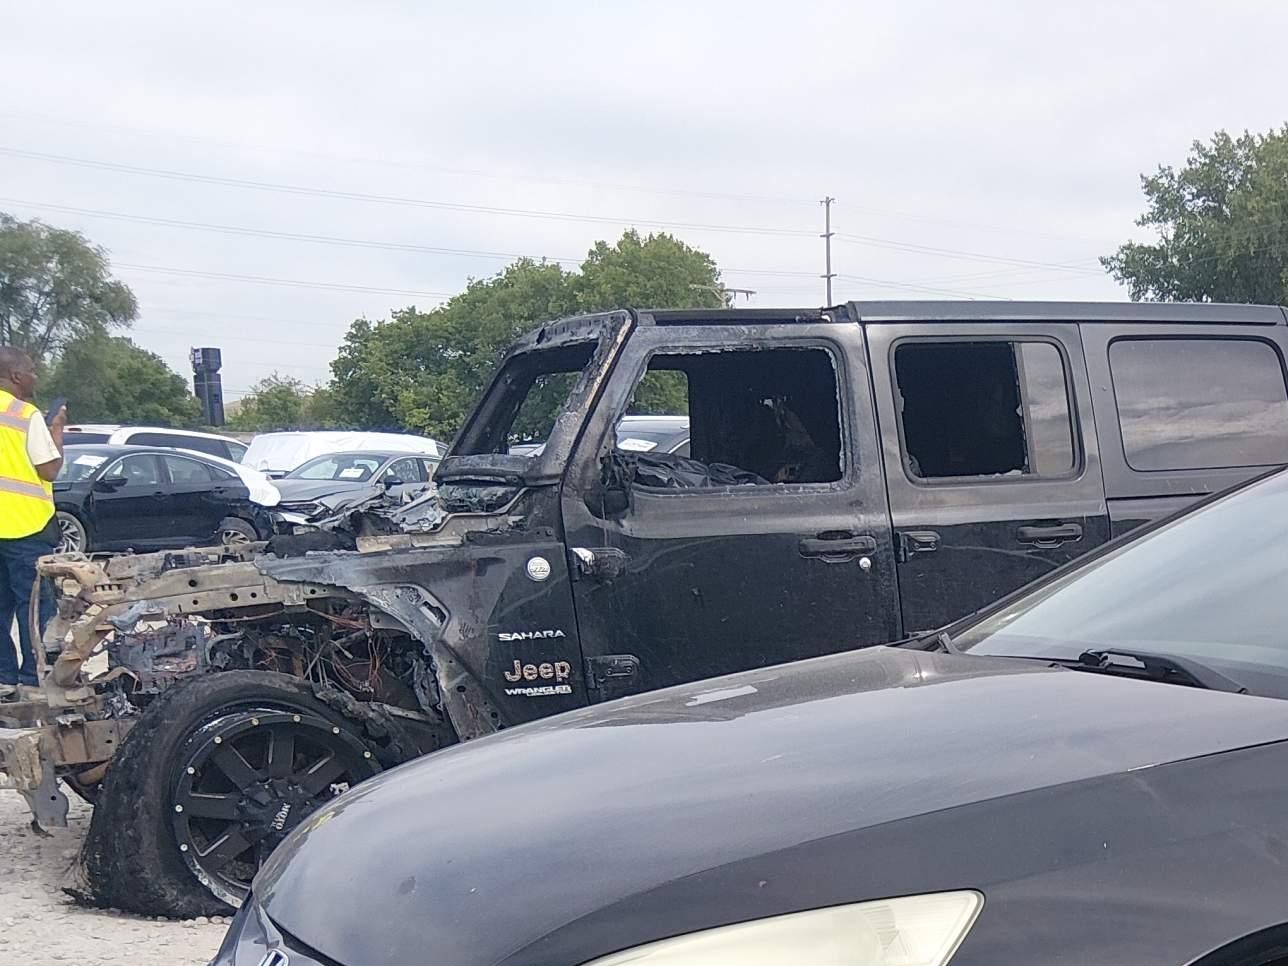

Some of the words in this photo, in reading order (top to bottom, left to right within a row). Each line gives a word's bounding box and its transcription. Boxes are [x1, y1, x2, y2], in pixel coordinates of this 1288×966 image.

[498, 630, 566, 641] SAHARA
[504, 659, 571, 682] Jeep
[504, 685, 572, 696] WRANGLER
